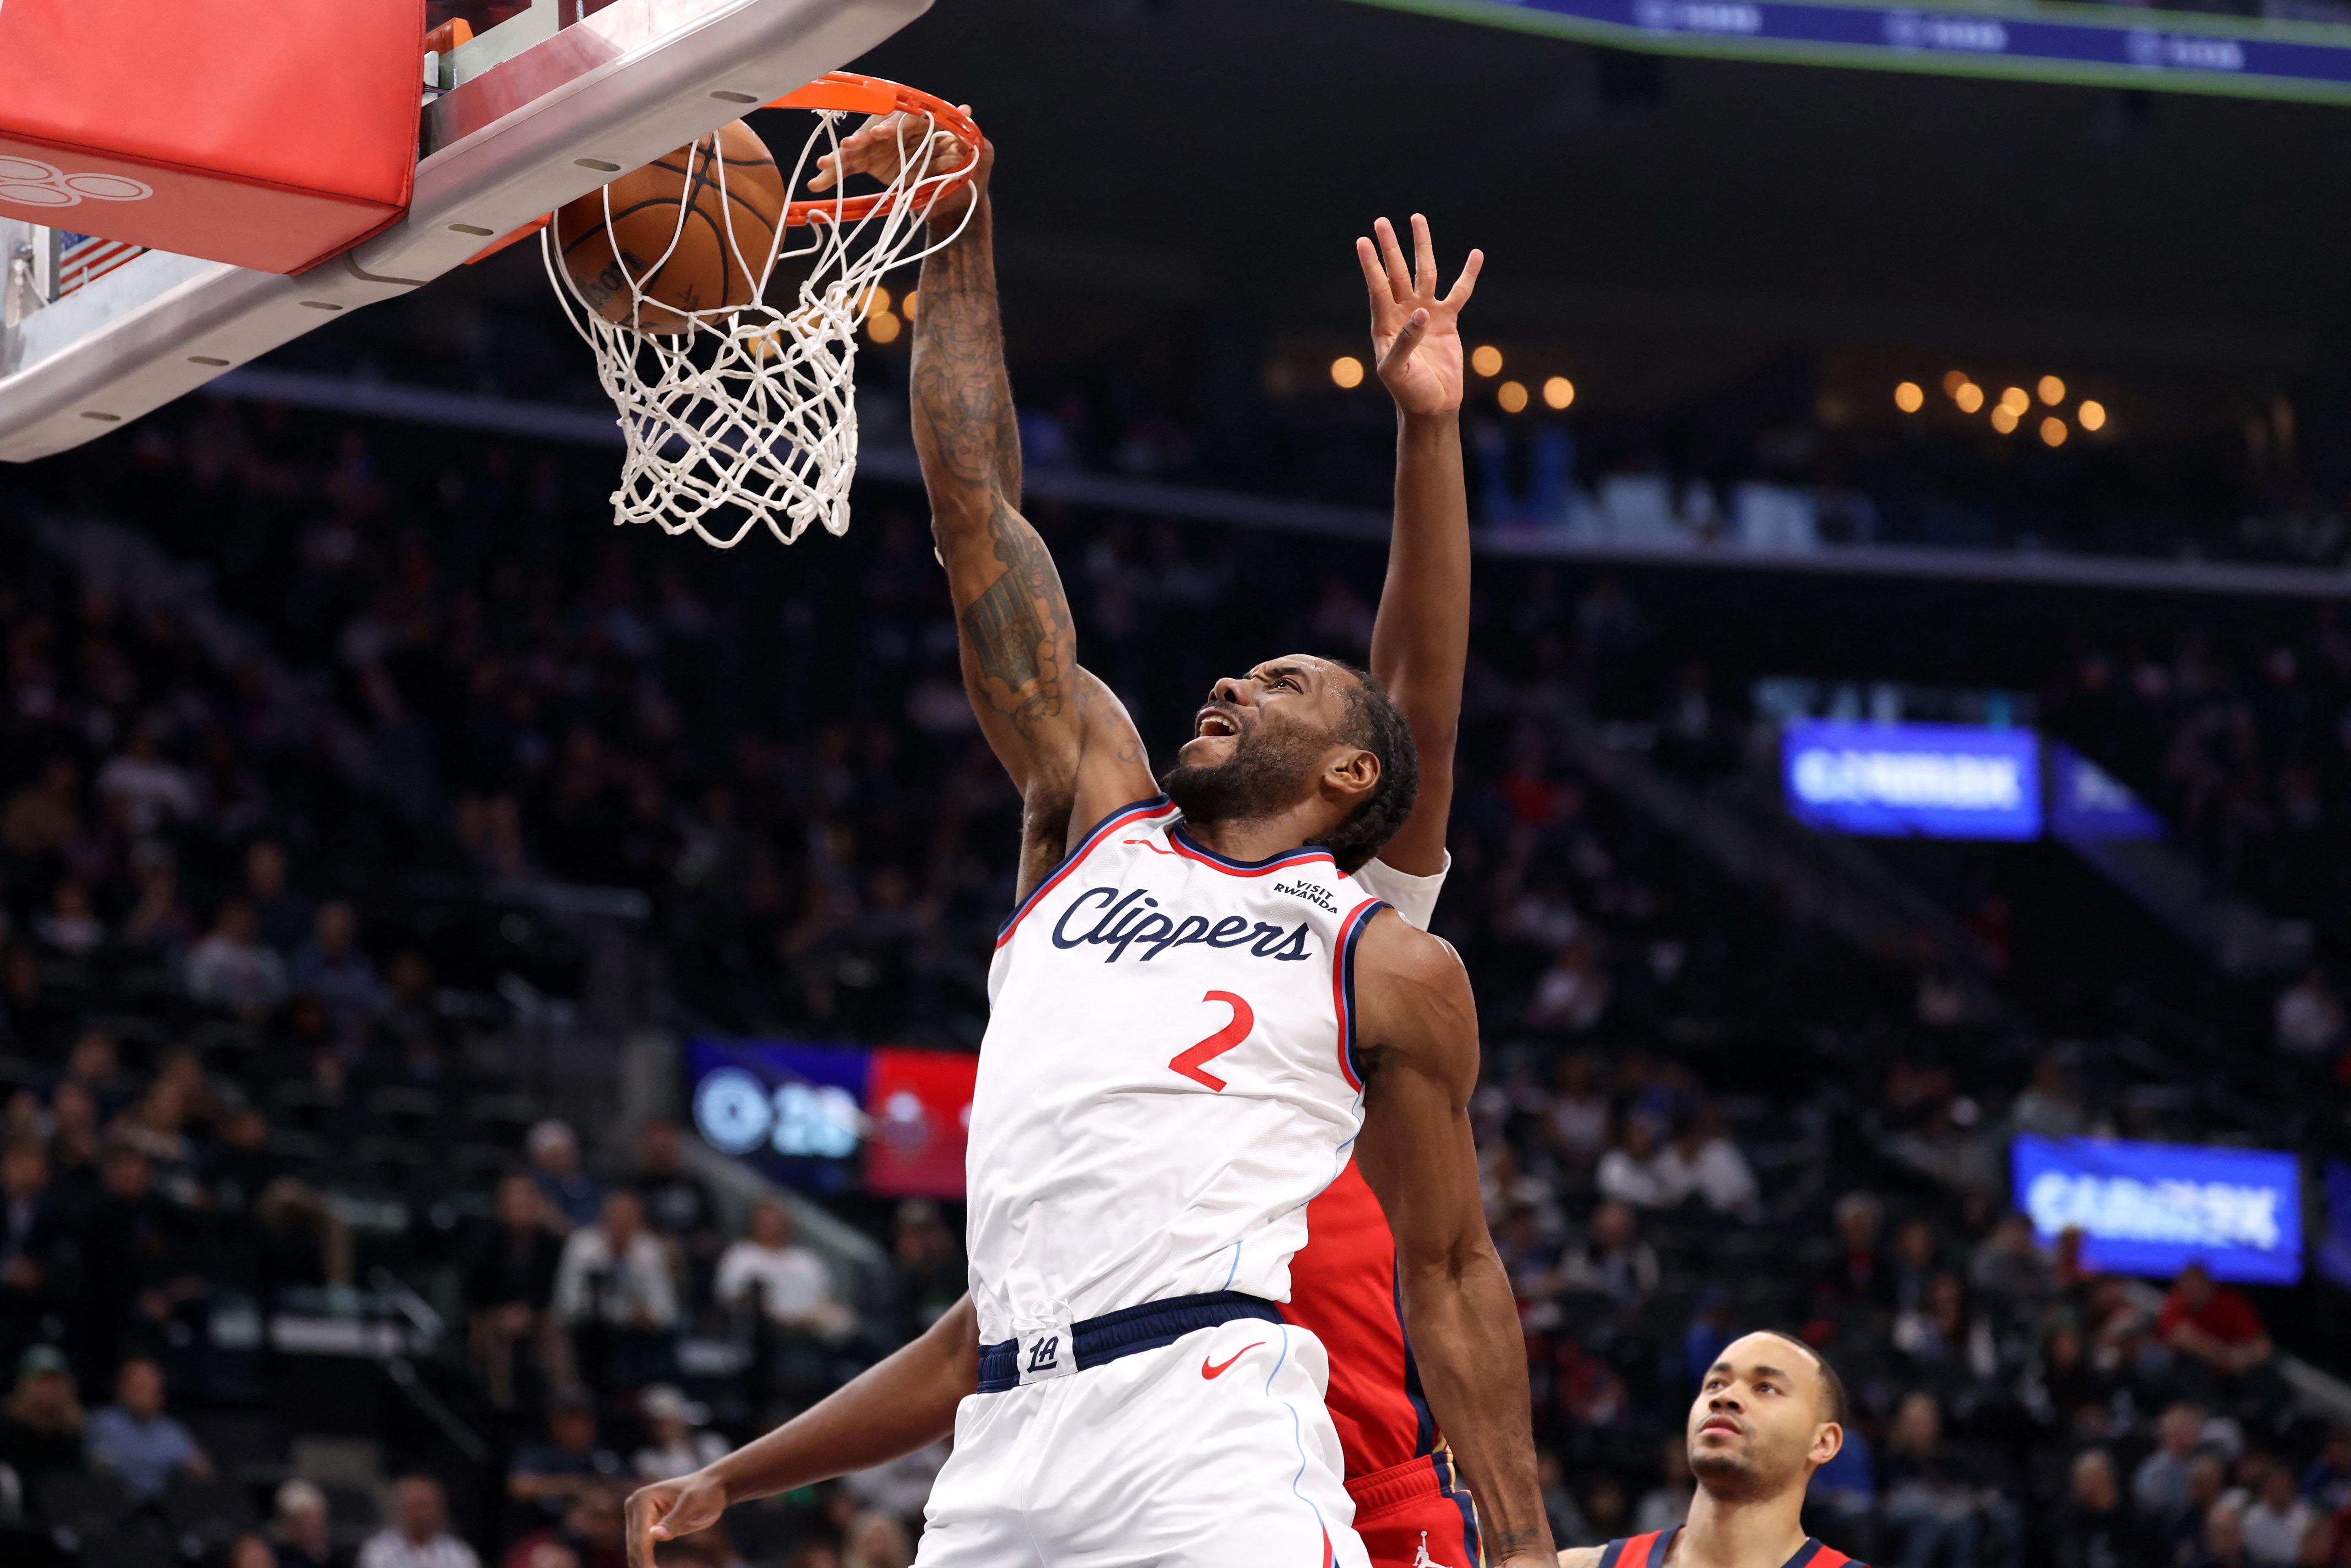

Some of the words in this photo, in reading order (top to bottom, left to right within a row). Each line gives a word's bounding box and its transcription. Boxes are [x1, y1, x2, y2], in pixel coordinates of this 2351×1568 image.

[1273, 883, 1338, 914] RWANDA
[1296, 880, 1334, 900] VISIT
[1052, 887, 1312, 963] Clippers
[1168, 990, 1254, 1092] 2
[1026, 1336, 1059, 1373] LA
